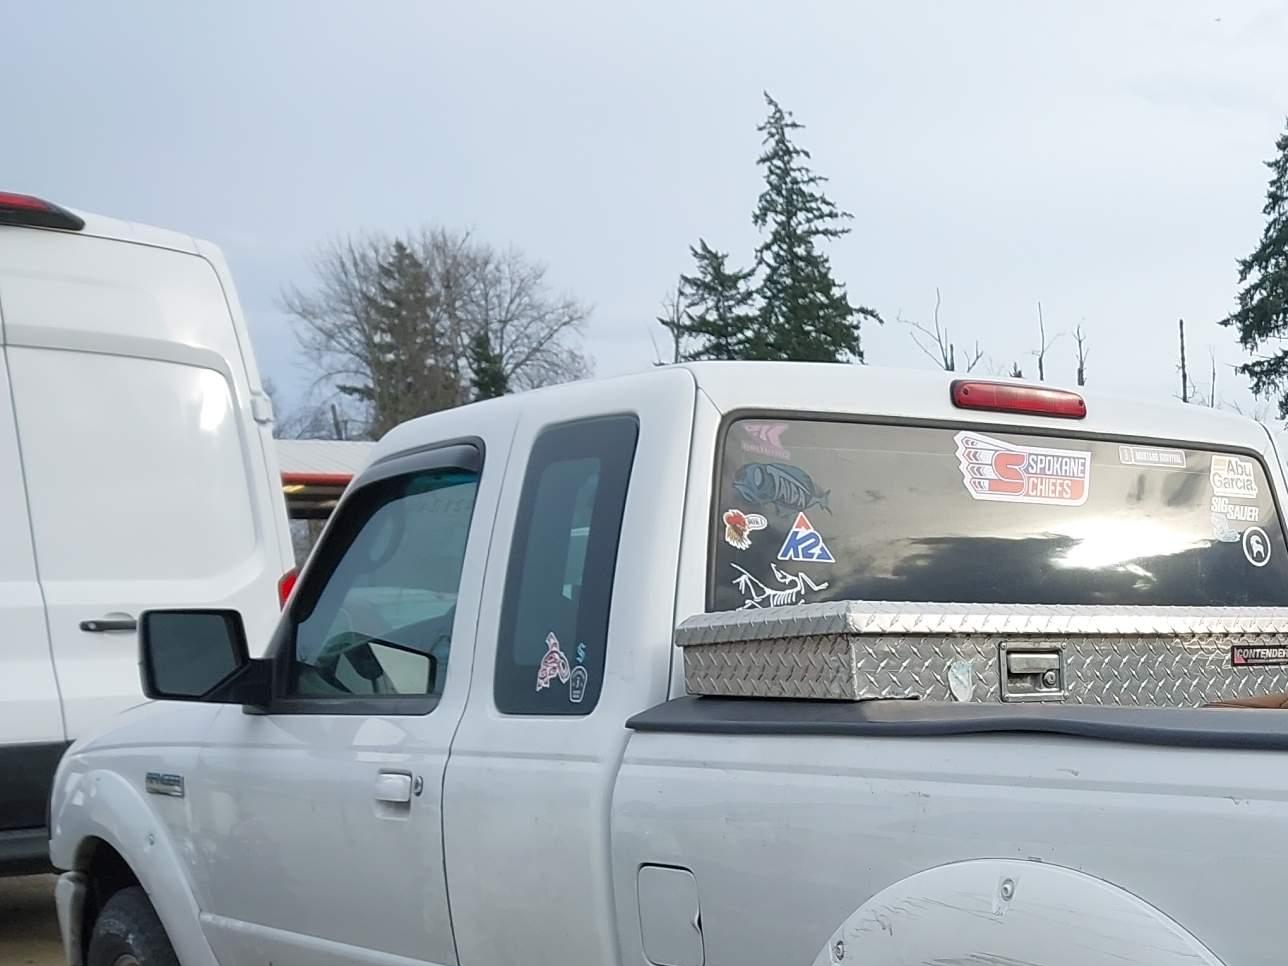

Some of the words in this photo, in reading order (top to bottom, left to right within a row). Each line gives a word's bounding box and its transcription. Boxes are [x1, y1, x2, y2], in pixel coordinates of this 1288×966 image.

[1028, 454, 1086, 477] SPOKANE
[1226, 458, 1253, 477] Abu
[1028, 477, 1072, 499] CHIEFS
[1211, 496, 1229, 513] SIG
[1227, 504, 1259, 522] SAUER
[779, 529, 822, 560] K2
